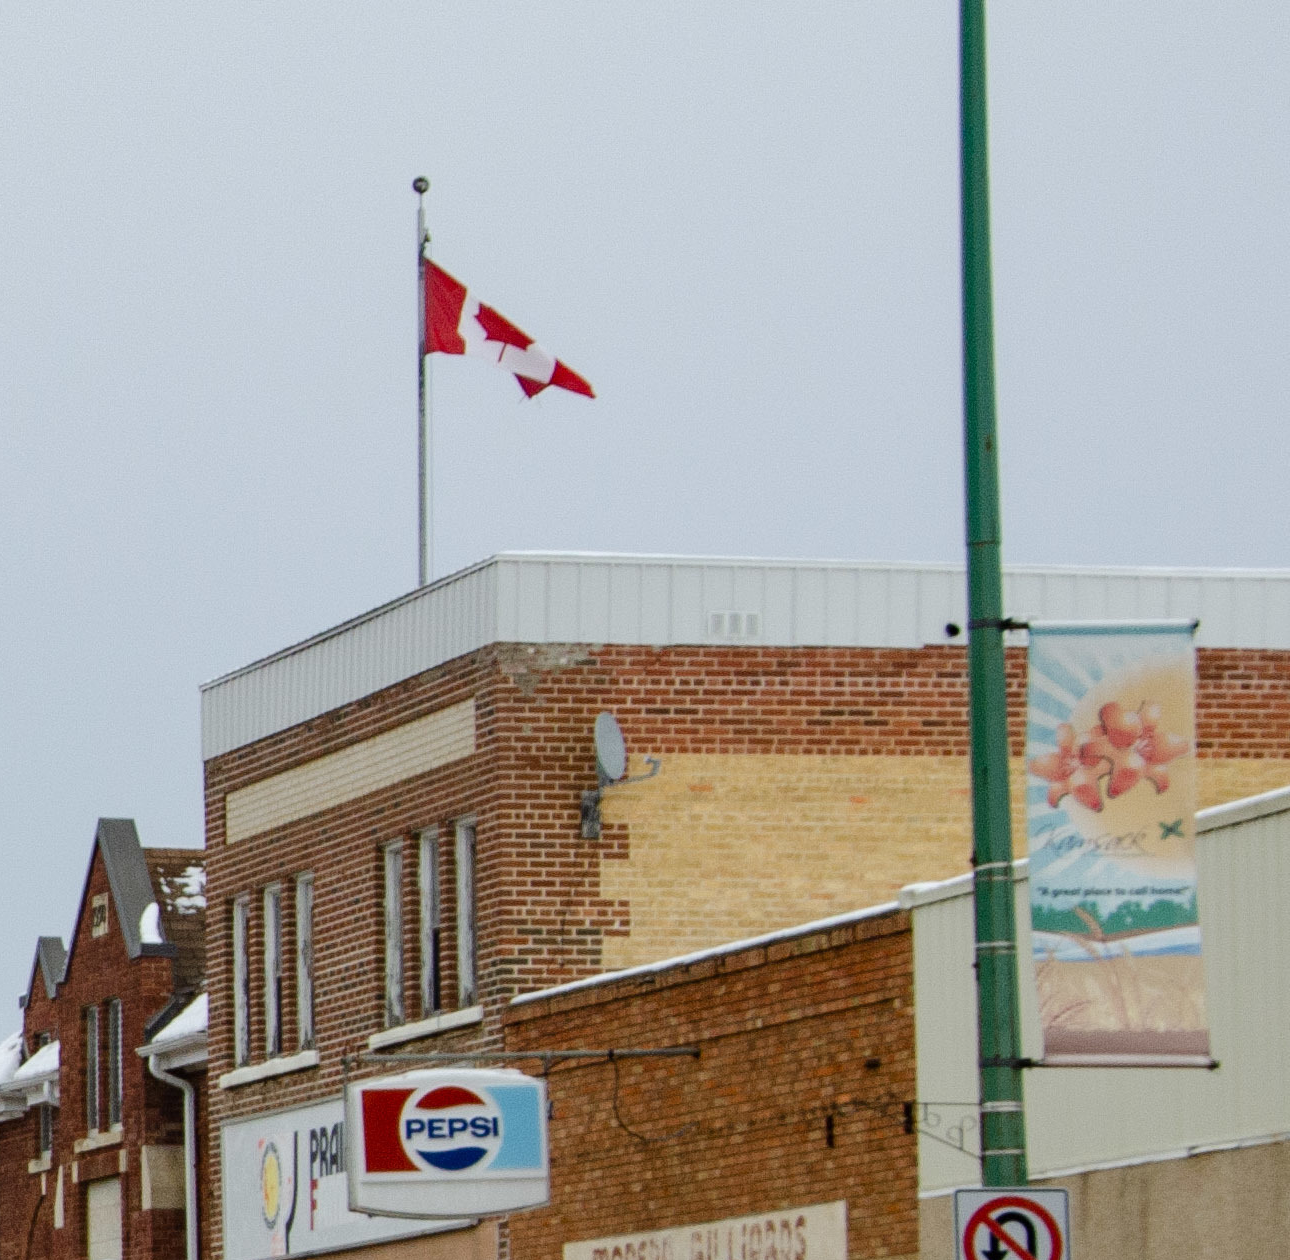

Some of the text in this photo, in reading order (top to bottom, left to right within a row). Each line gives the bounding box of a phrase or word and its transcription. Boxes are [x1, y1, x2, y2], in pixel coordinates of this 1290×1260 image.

[1052, 887, 1081, 898] great
[1083, 886, 1111, 898] place
[1130, 886, 1148, 896] call
[405, 1117, 500, 1140] PEPSI
[310, 1121, 344, 1180] PRAI
